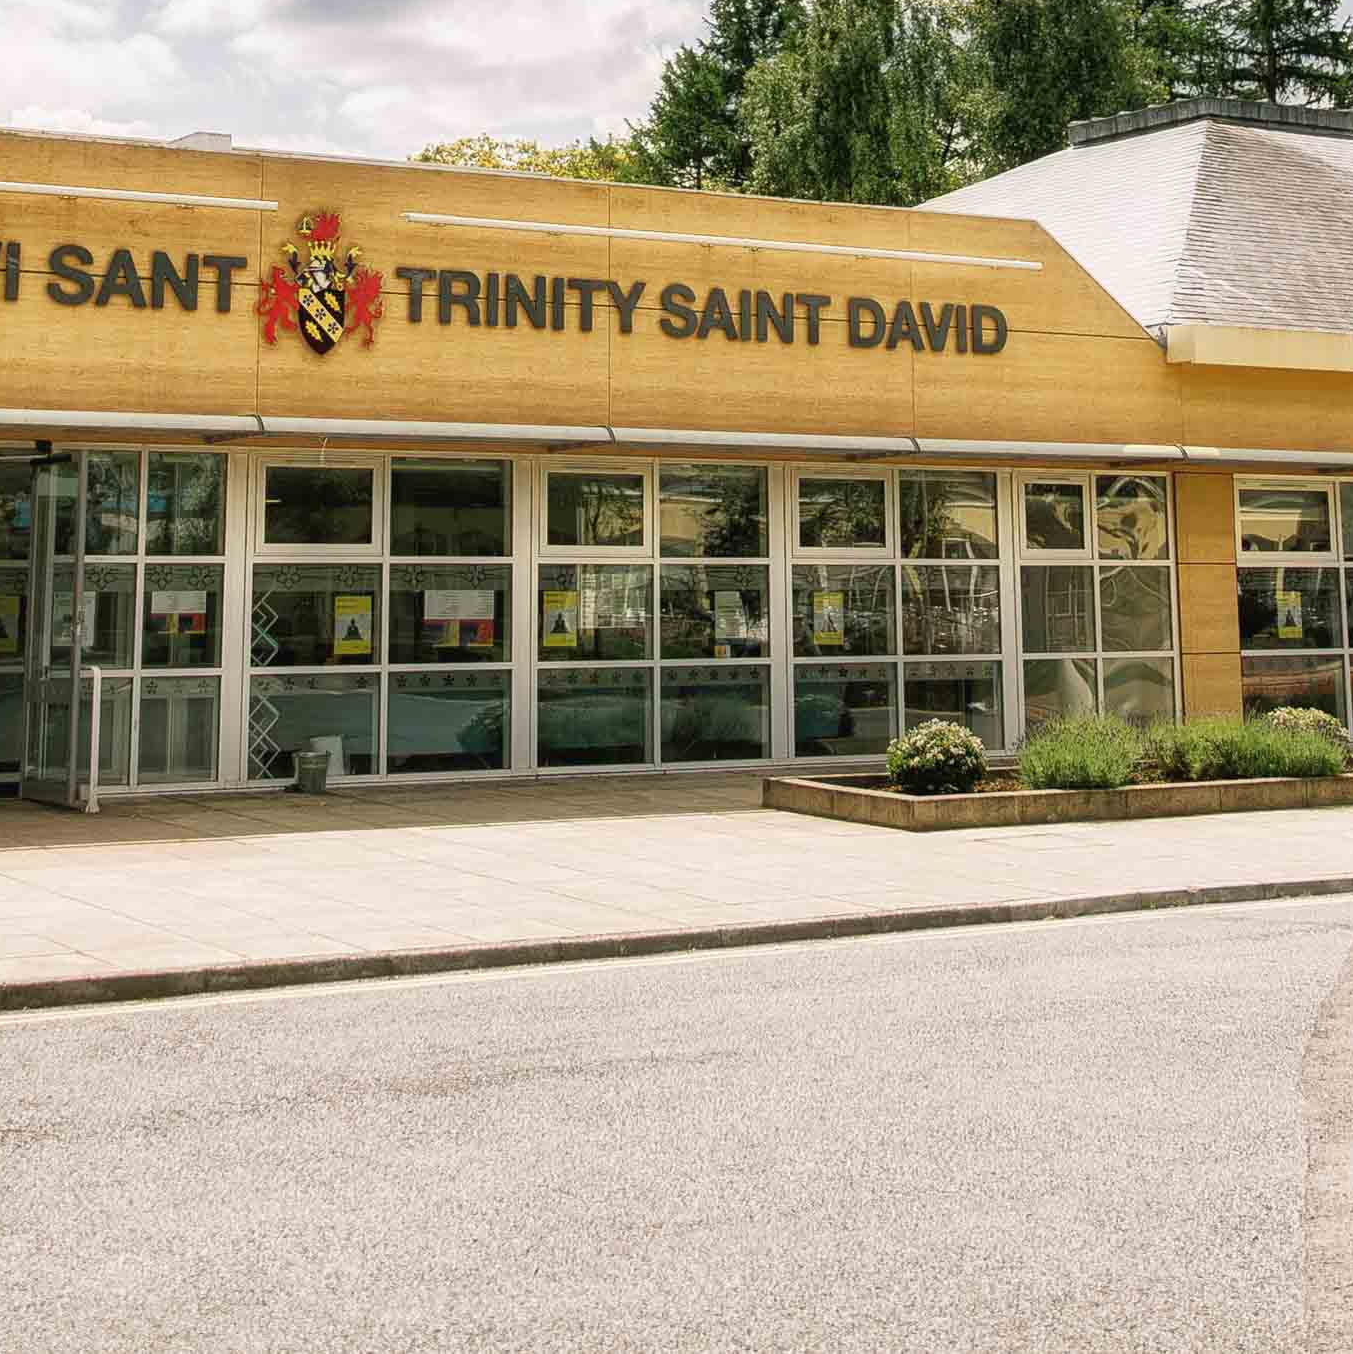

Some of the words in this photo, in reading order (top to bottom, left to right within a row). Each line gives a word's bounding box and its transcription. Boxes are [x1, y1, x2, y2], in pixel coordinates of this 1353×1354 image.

[47, 244, 247, 312] SANT
[396, 267, 646, 334] TRINITY
[660, 282, 831, 345] SAINT
[848, 296, 1009, 356] DAVID
